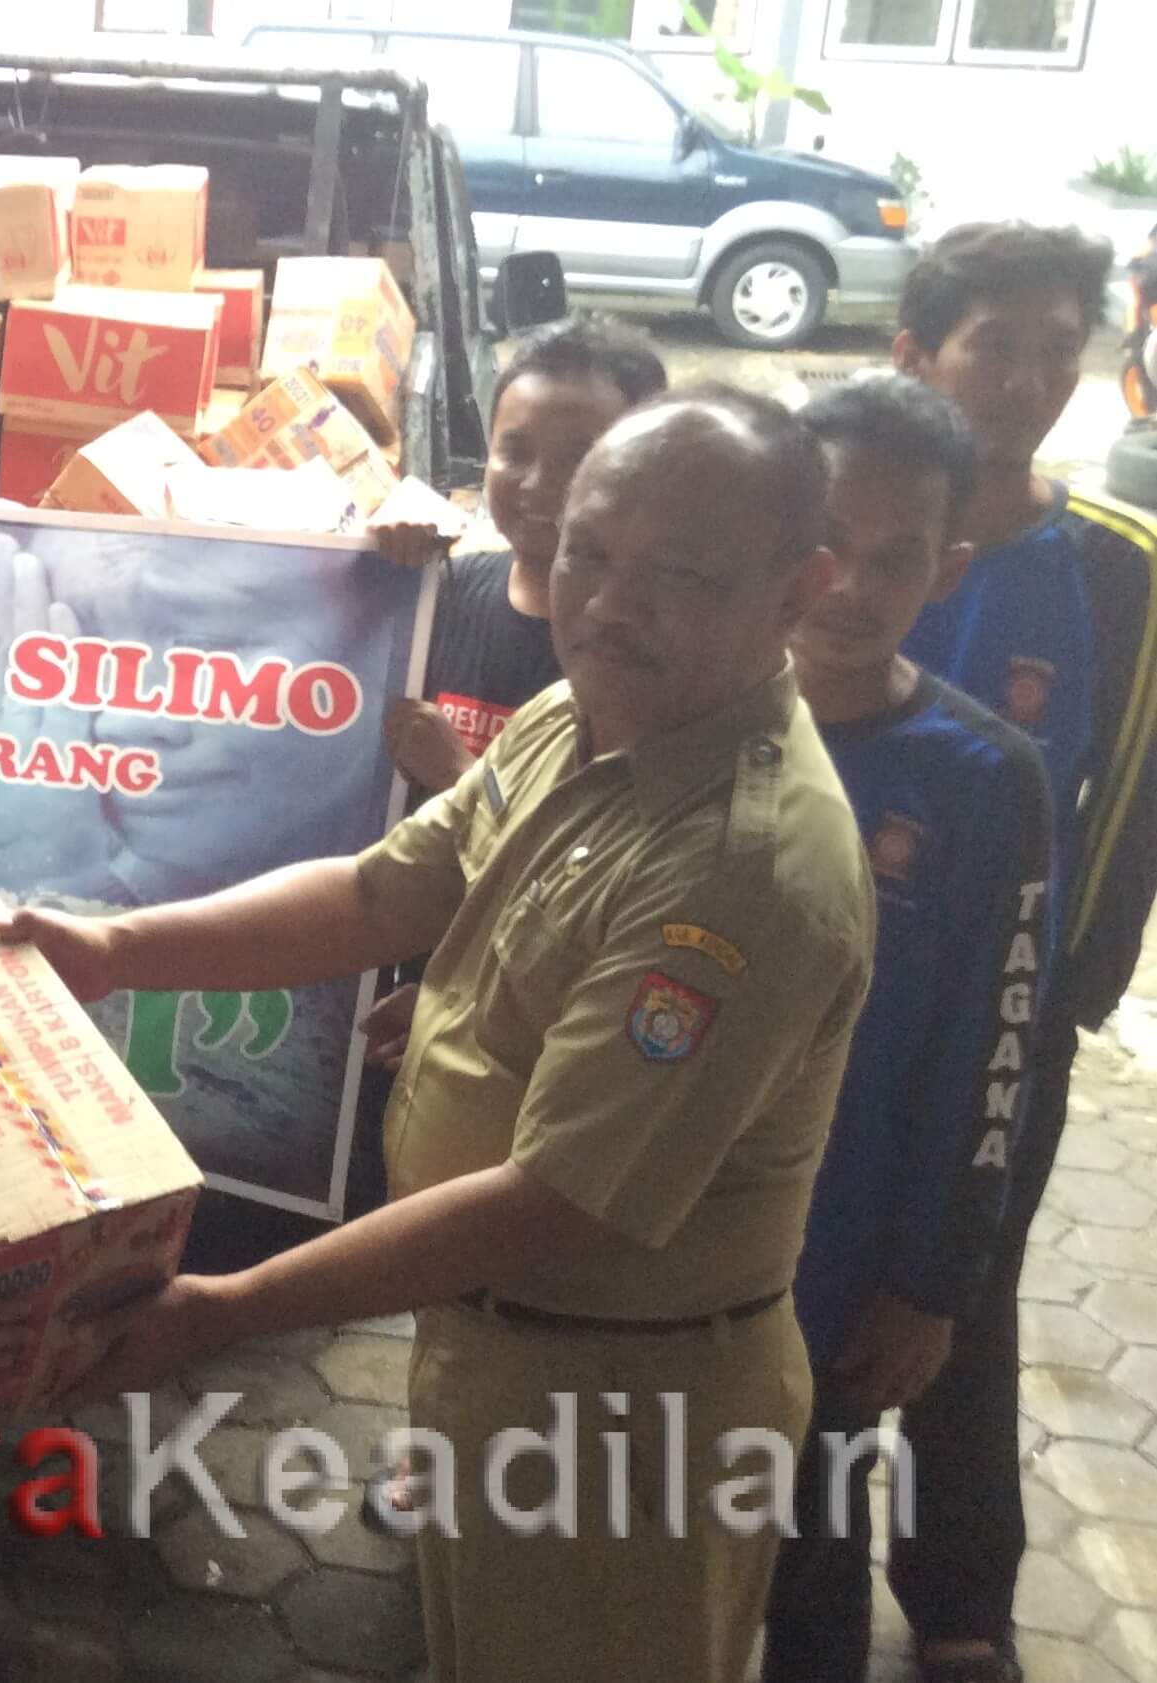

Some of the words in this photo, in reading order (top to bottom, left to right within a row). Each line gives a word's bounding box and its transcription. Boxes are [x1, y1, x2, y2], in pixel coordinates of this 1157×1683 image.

[44, 316, 170, 405] Vit
[7, 634, 360, 734] SILIMO
[971, 880, 1045, 1168] TAGANA
